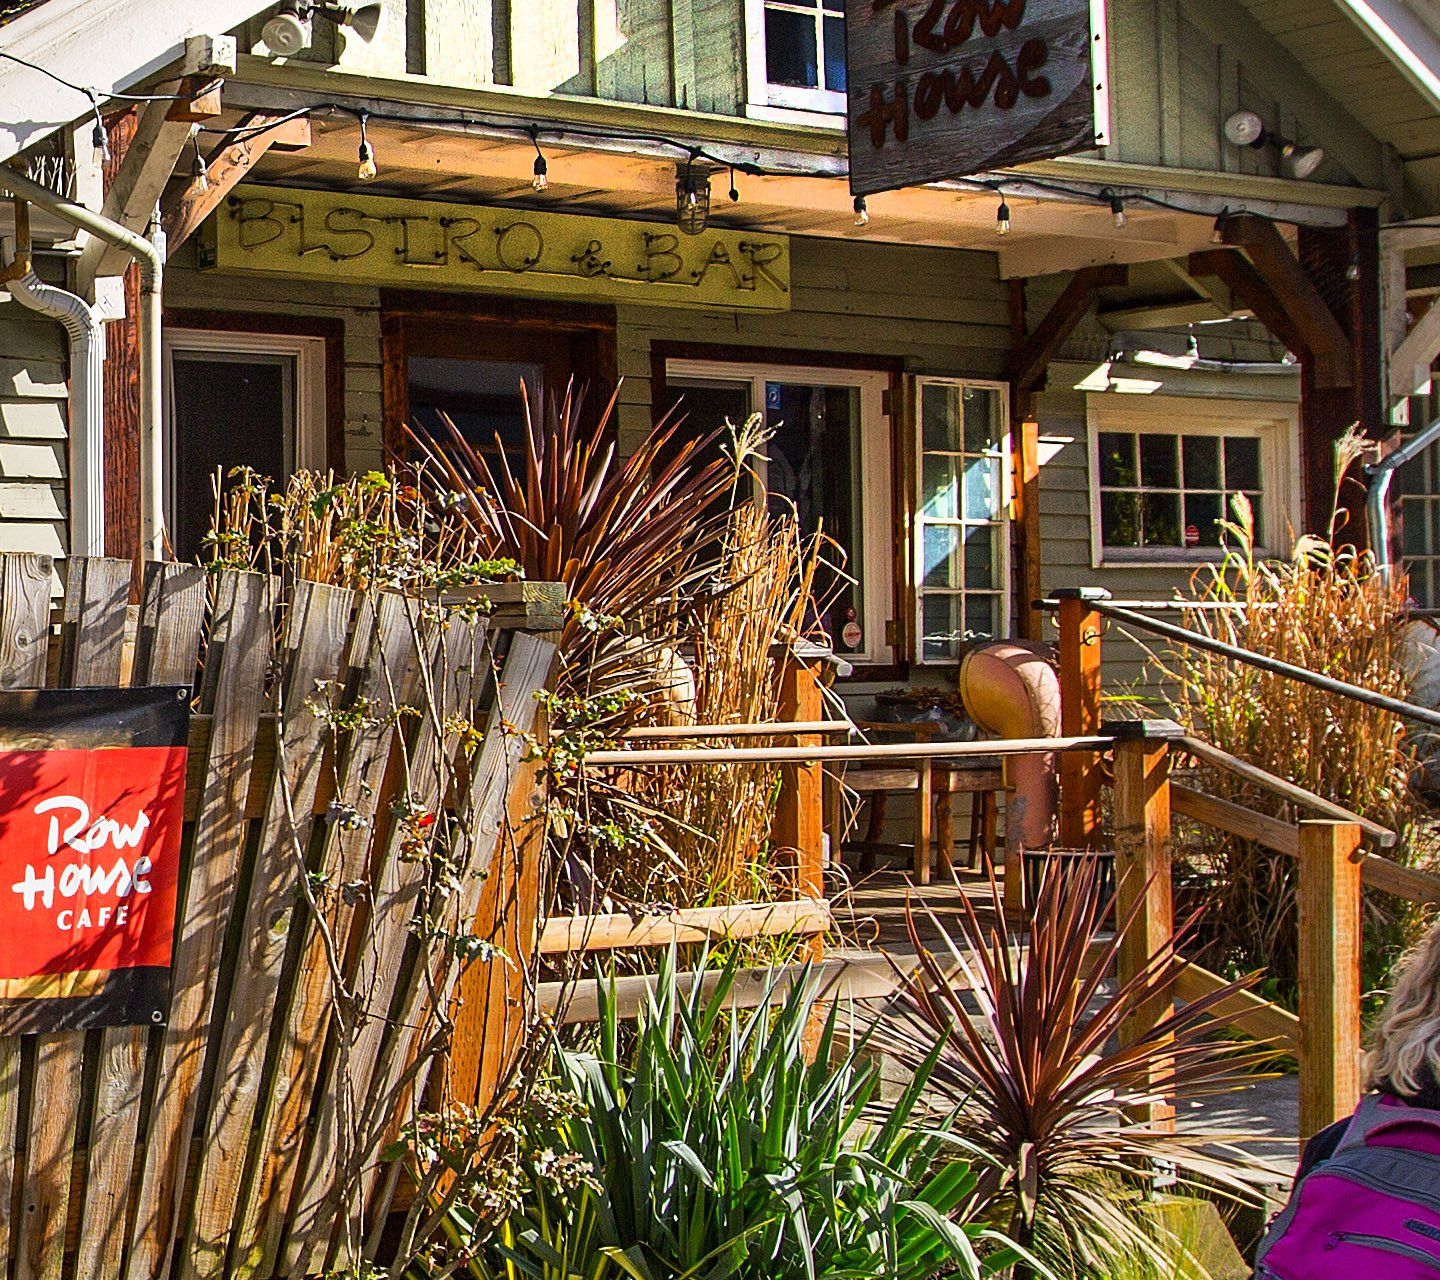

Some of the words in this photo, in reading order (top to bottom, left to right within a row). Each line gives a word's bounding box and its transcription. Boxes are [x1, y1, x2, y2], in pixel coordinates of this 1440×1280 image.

[856, 38, 1052, 149] House
[227, 197, 543, 274] BISTRO
[570, 239, 611, 278] &
[637, 232, 788, 292] BAR
[33, 795, 151, 855] Row
[11, 856, 153, 911] House
[56, 905, 129, 931] CAFE
